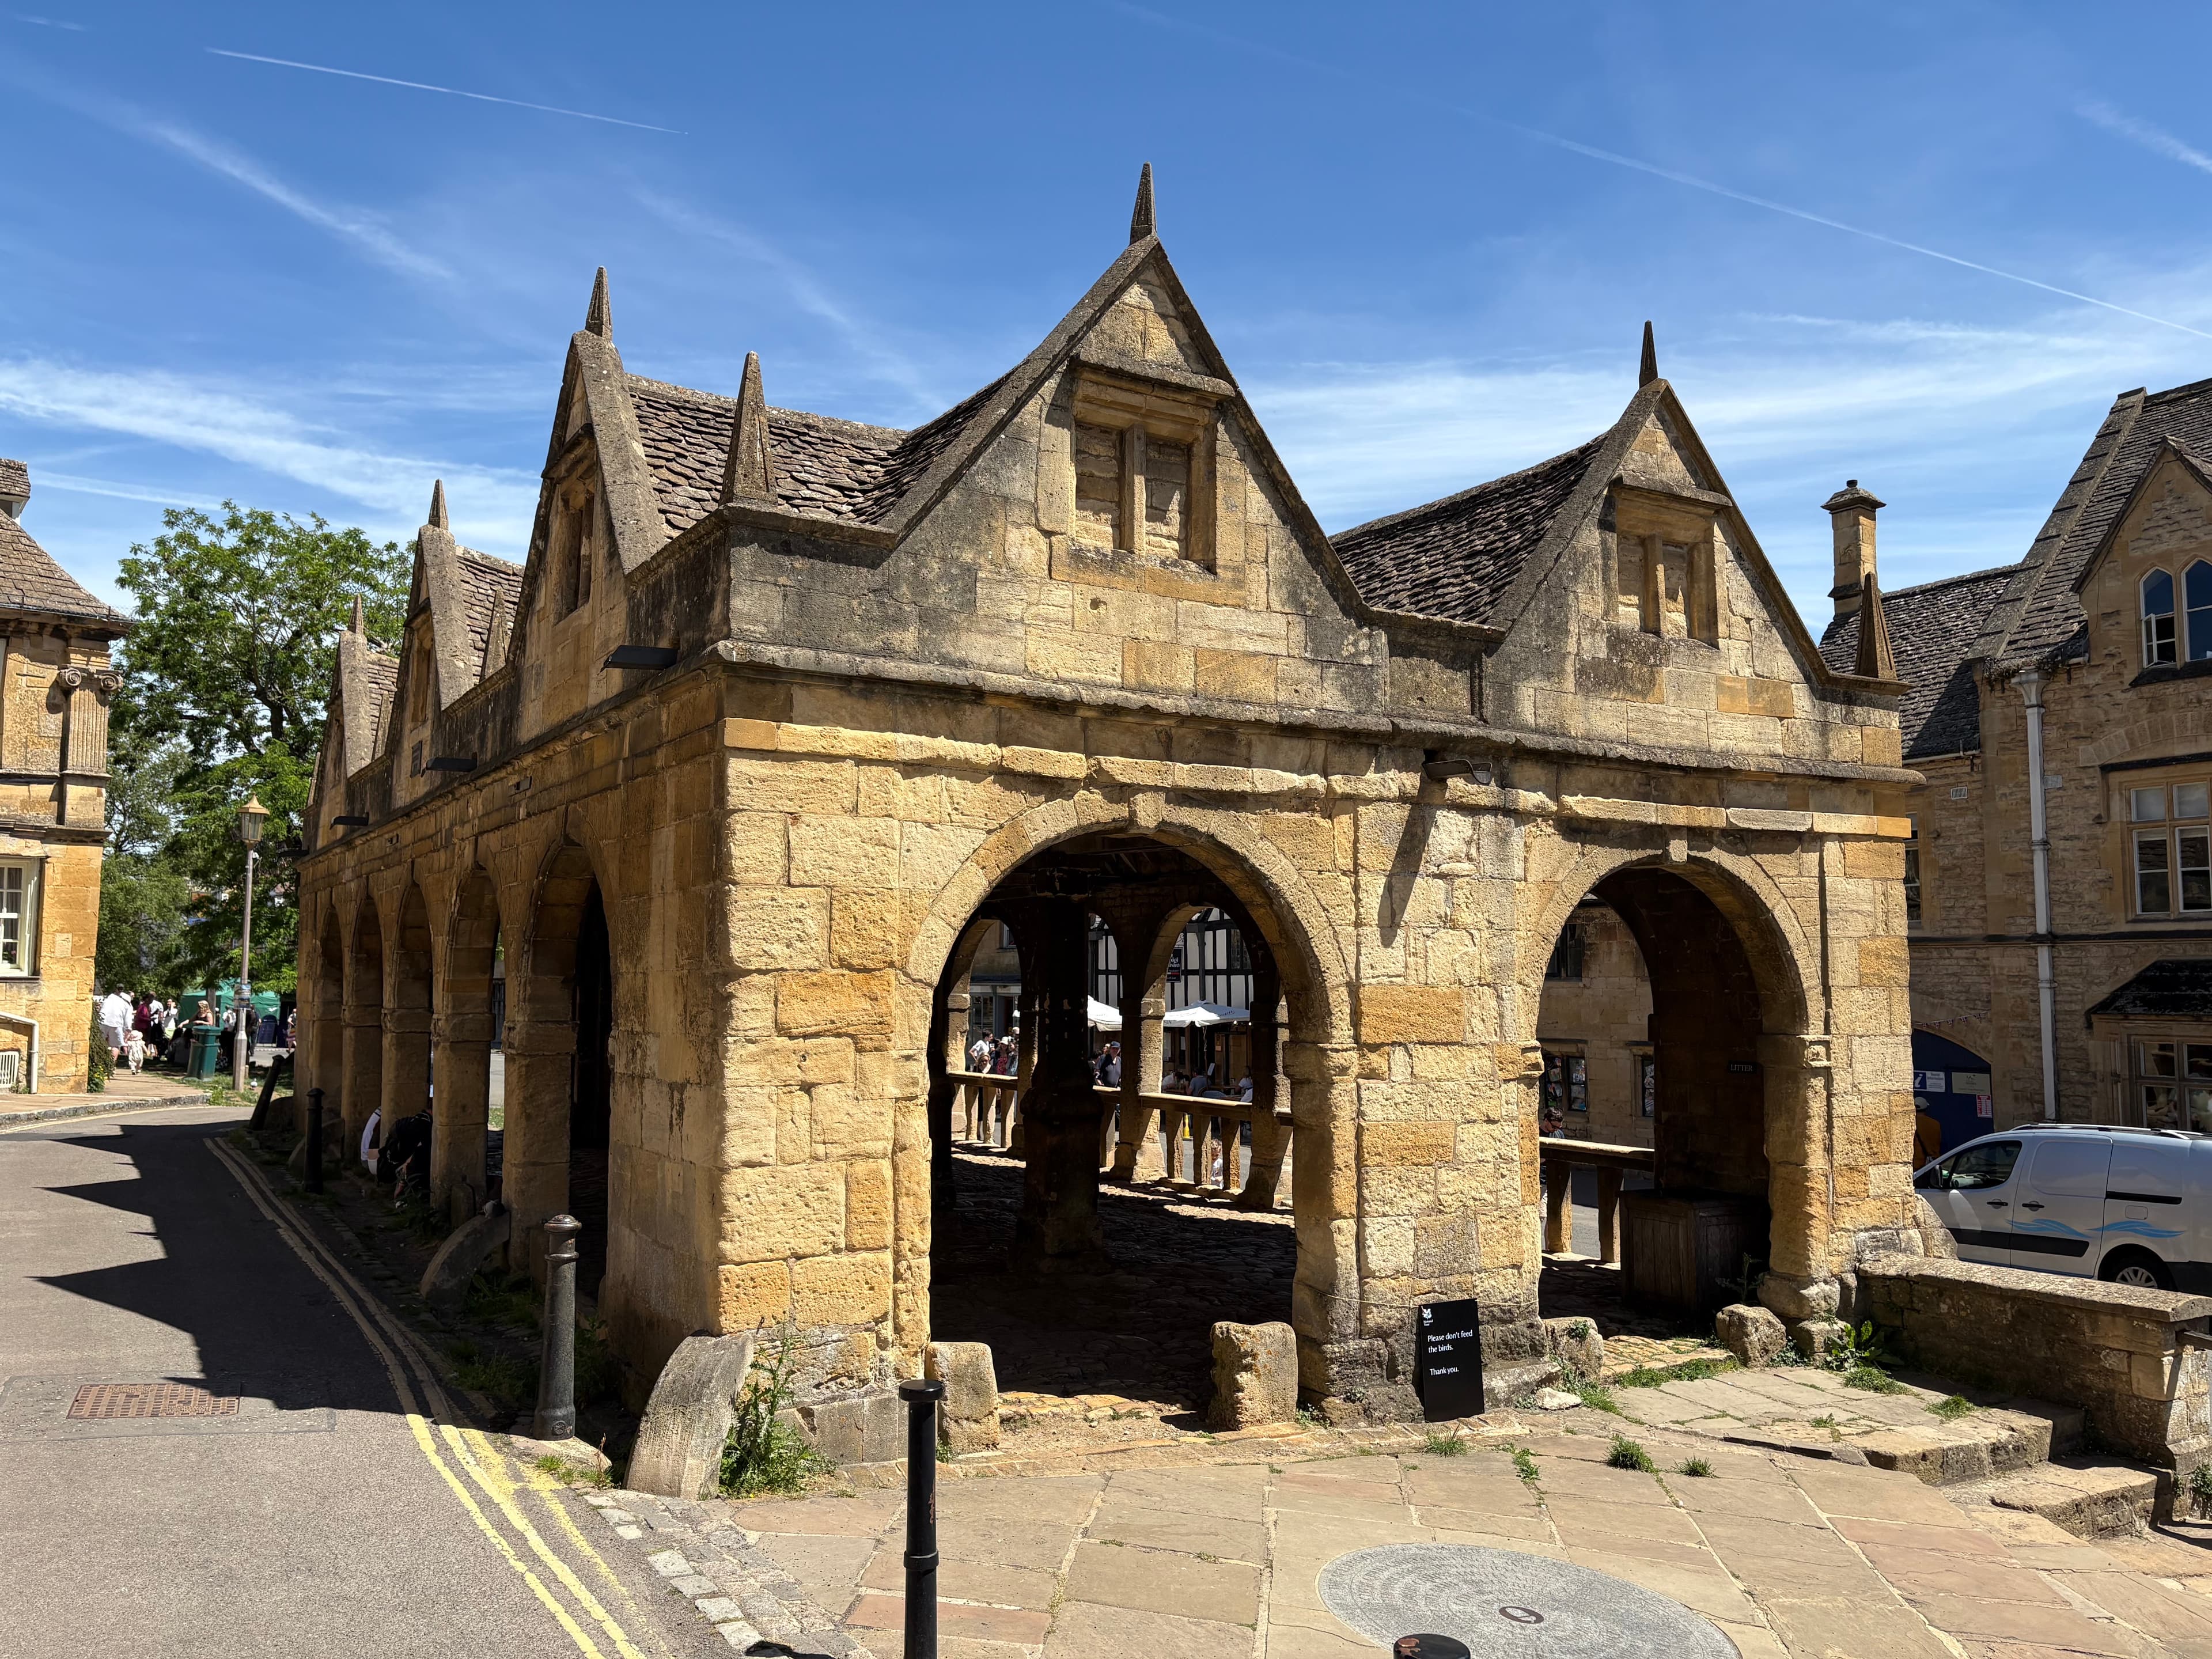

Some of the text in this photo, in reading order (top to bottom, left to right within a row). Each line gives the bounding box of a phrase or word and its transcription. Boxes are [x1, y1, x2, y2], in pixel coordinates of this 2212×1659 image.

[1427, 1330, 1473, 1342] Please don't feed
[1429, 1366, 1459, 1376] Thank you.
